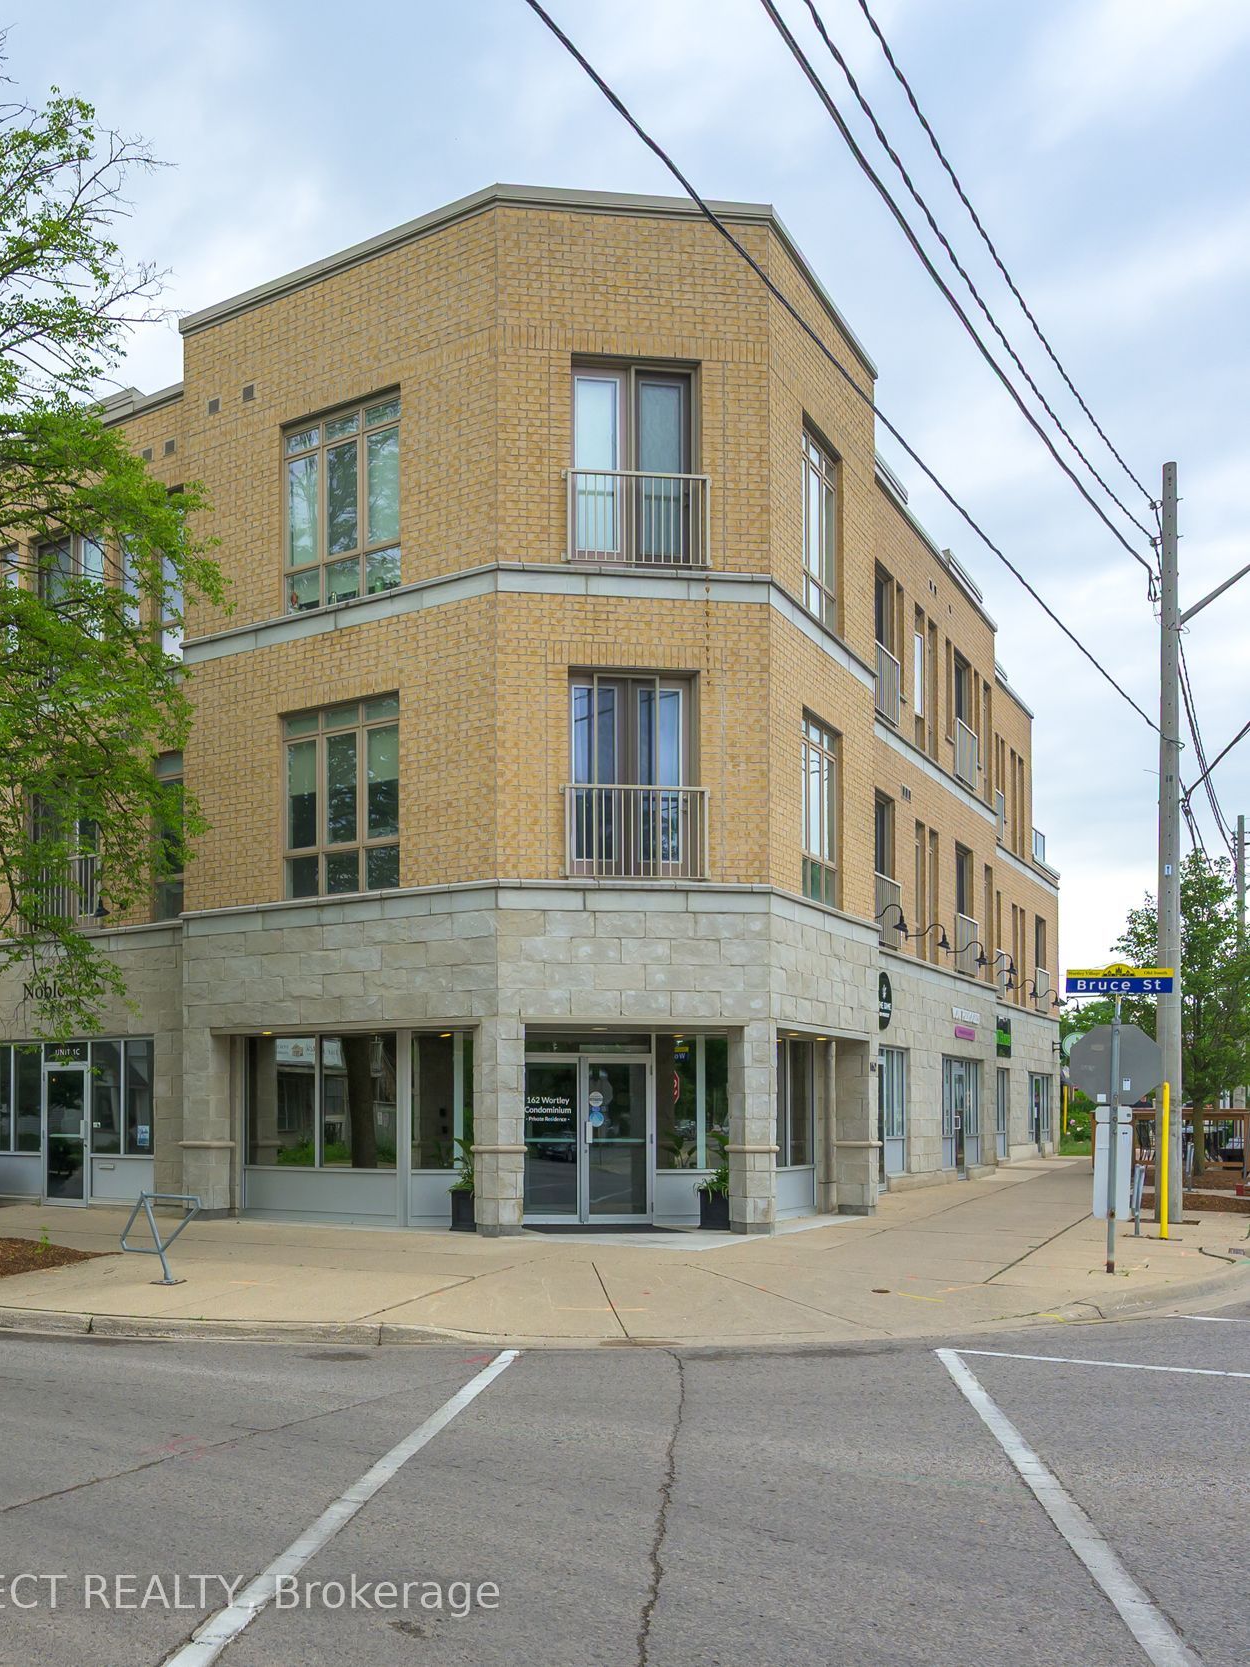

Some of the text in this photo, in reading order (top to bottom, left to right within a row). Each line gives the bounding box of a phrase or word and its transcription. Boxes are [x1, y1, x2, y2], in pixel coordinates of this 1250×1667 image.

[1076, 979, 1162, 991] Bruce St
[55, 1048, 81, 1056] UNIT 1C
[526, 1096, 570, 1106] 162 Wortley
[524, 1106, 572, 1114] Condominium
